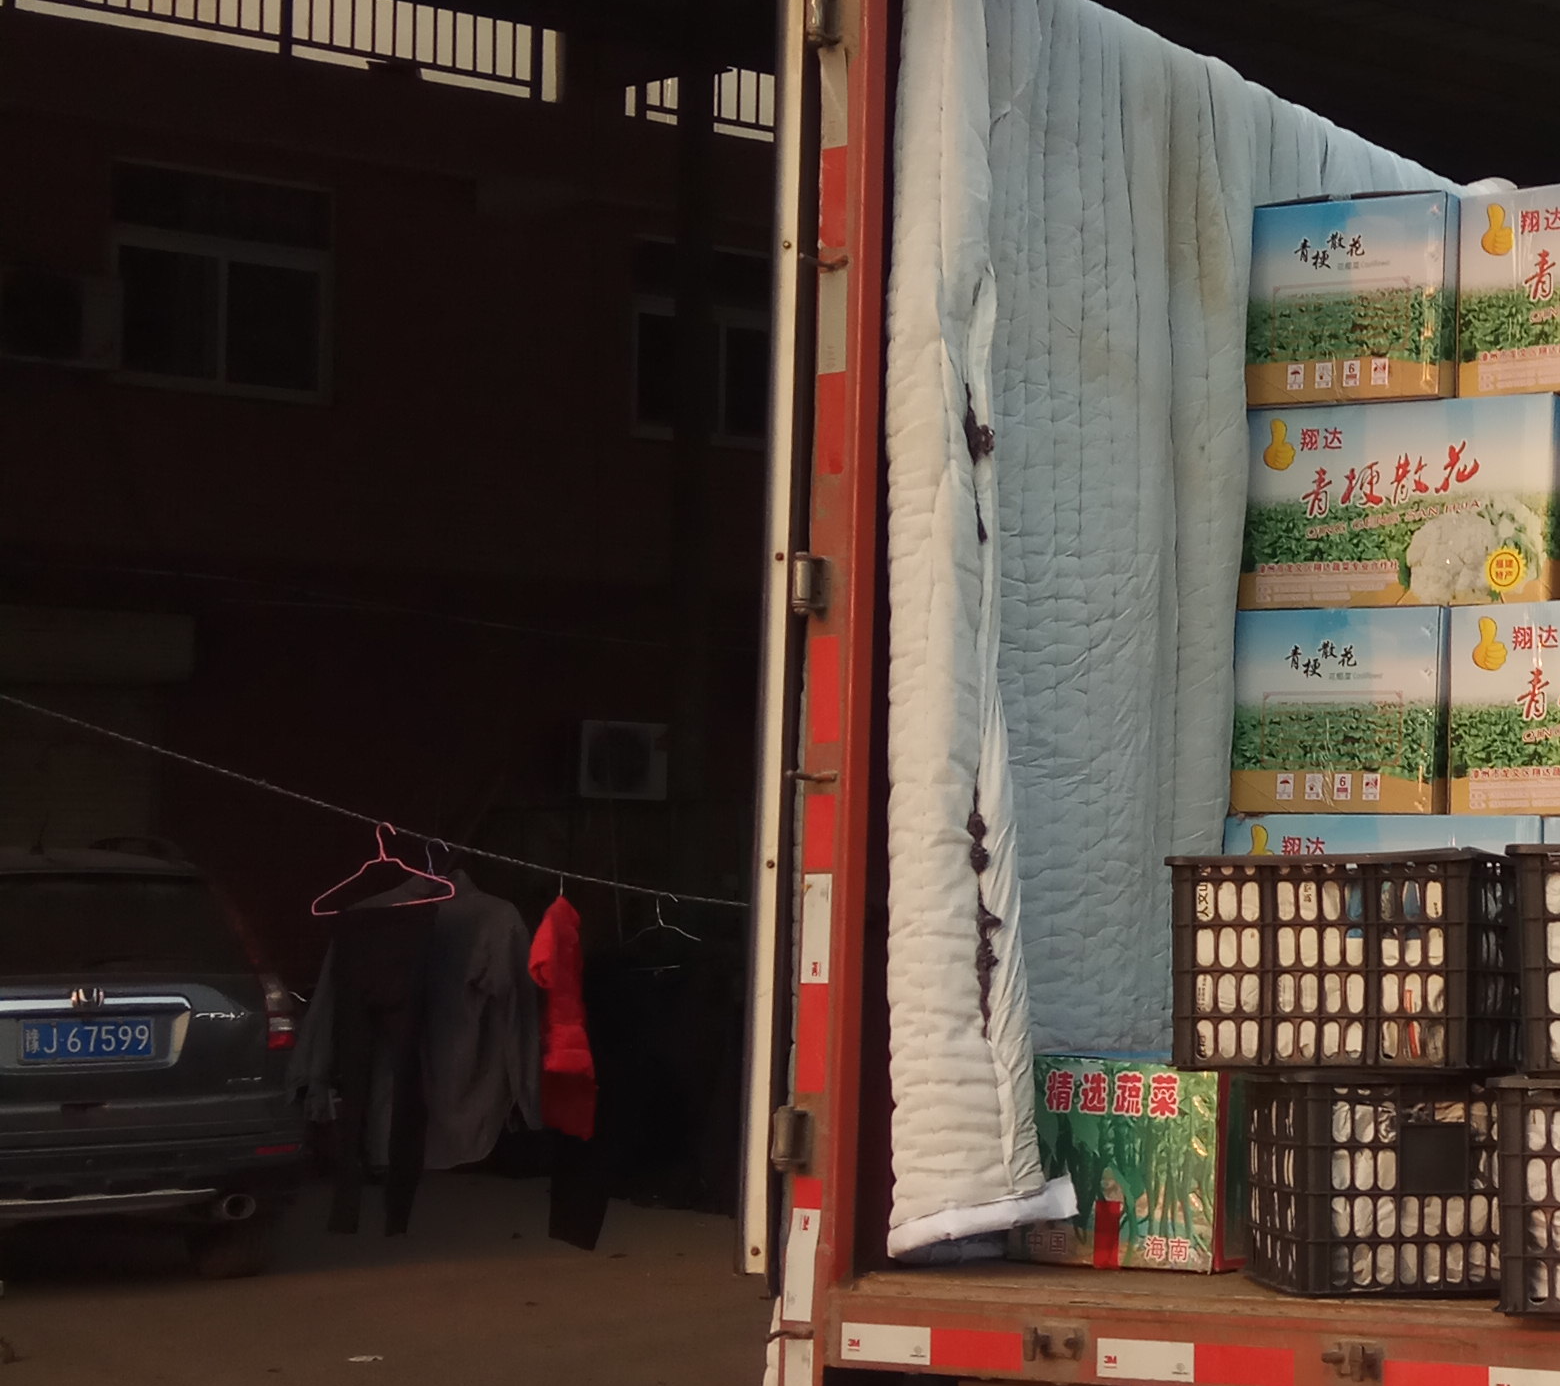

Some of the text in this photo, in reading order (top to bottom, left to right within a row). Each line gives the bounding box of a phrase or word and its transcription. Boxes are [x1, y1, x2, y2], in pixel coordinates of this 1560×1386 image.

[1300, 427, 1343, 451] 翔达
[1301, 439, 1480, 519] 青梗散花
[1512, 624, 1559, 651] 翔达
[1281, 835, 1326, 855] 翔达
[1045, 1071, 1179, 1118] 精选蔬菜
[1144, 1236, 1190, 1262] 海南
